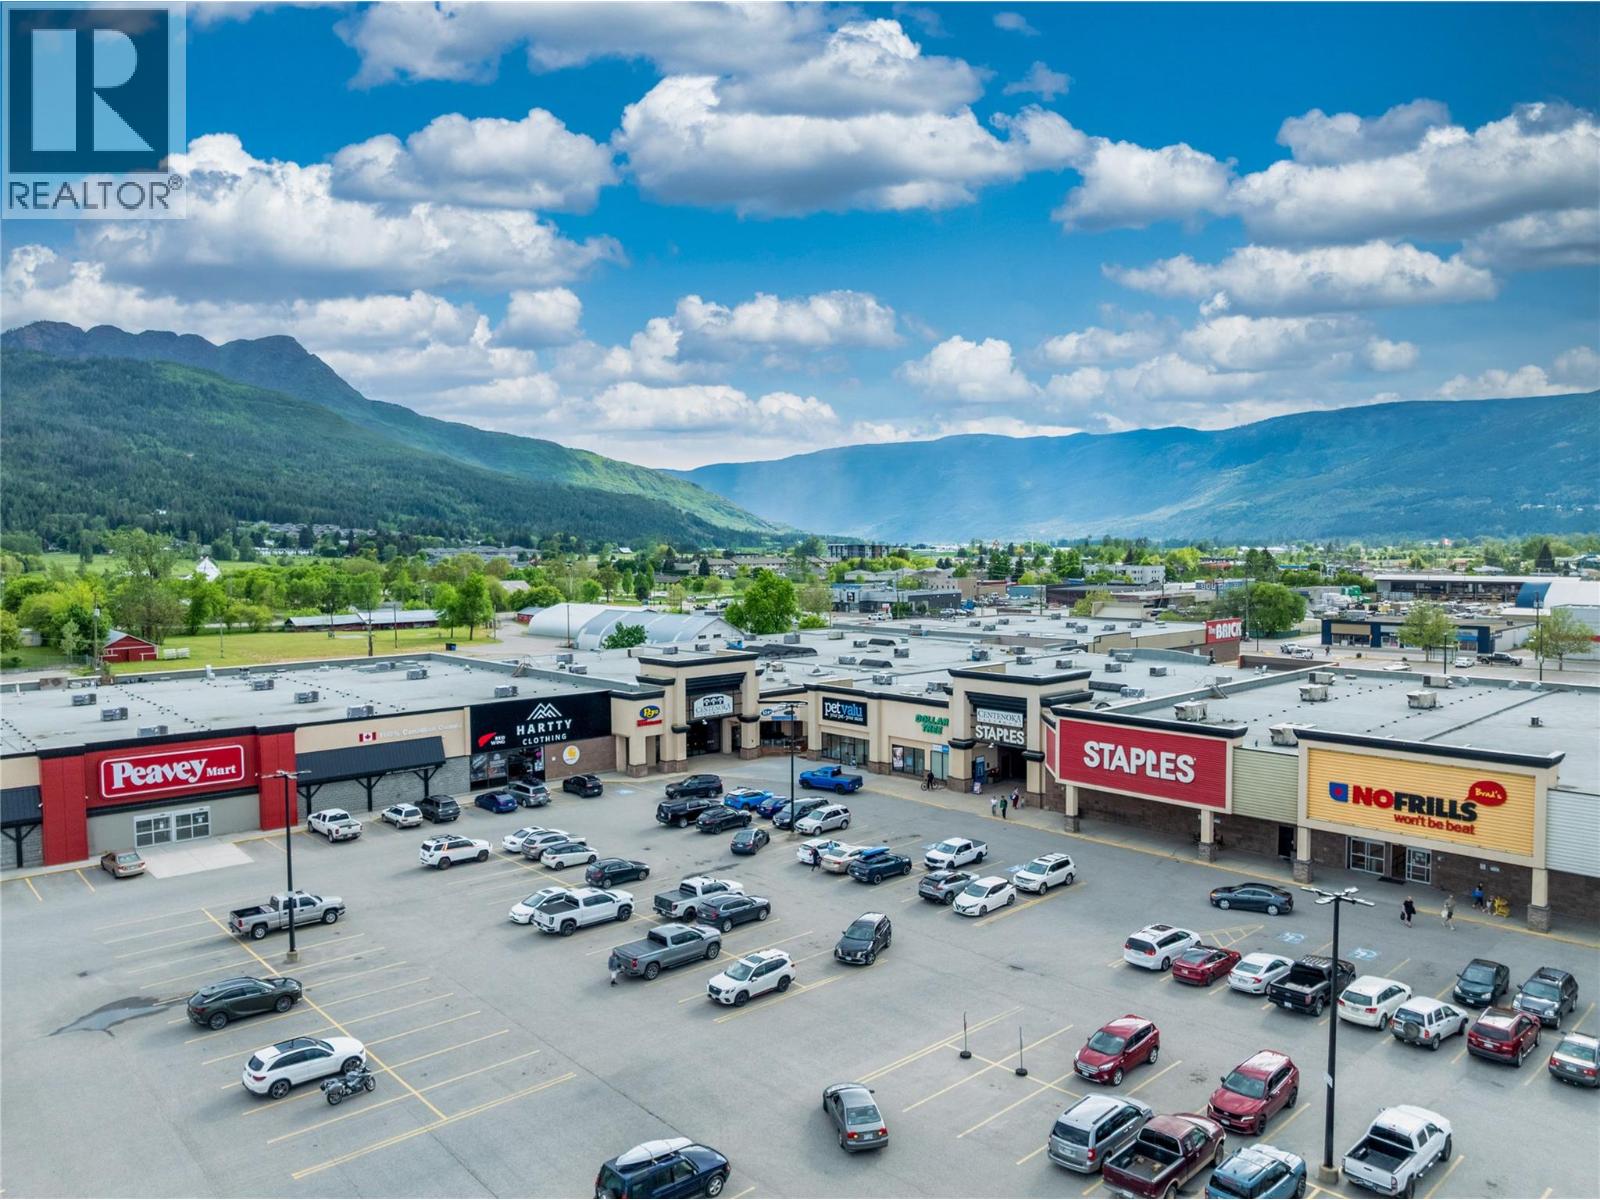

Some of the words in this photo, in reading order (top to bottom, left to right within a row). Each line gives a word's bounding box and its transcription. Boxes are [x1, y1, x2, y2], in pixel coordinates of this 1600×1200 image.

[1216, 621, 1242, 639] BRICK
[915, 714, 950, 727] DOLLAR
[977, 709, 1022, 724] CENTENOKA
[516, 718, 572, 736] HARTTY
[975, 725, 1025, 745] STAPLES
[522, 733, 567, 746] CLOTHING
[1083, 740, 1195, 784] STAPLES
[110, 758, 208, 790] Peavey
[206, 764, 237, 777] Mart
[1474, 787, 1503, 800] Brad's
[1394, 813, 1426, 828] won't
[1427, 817, 1444, 831] be
[1446, 820, 1476, 835] beat
